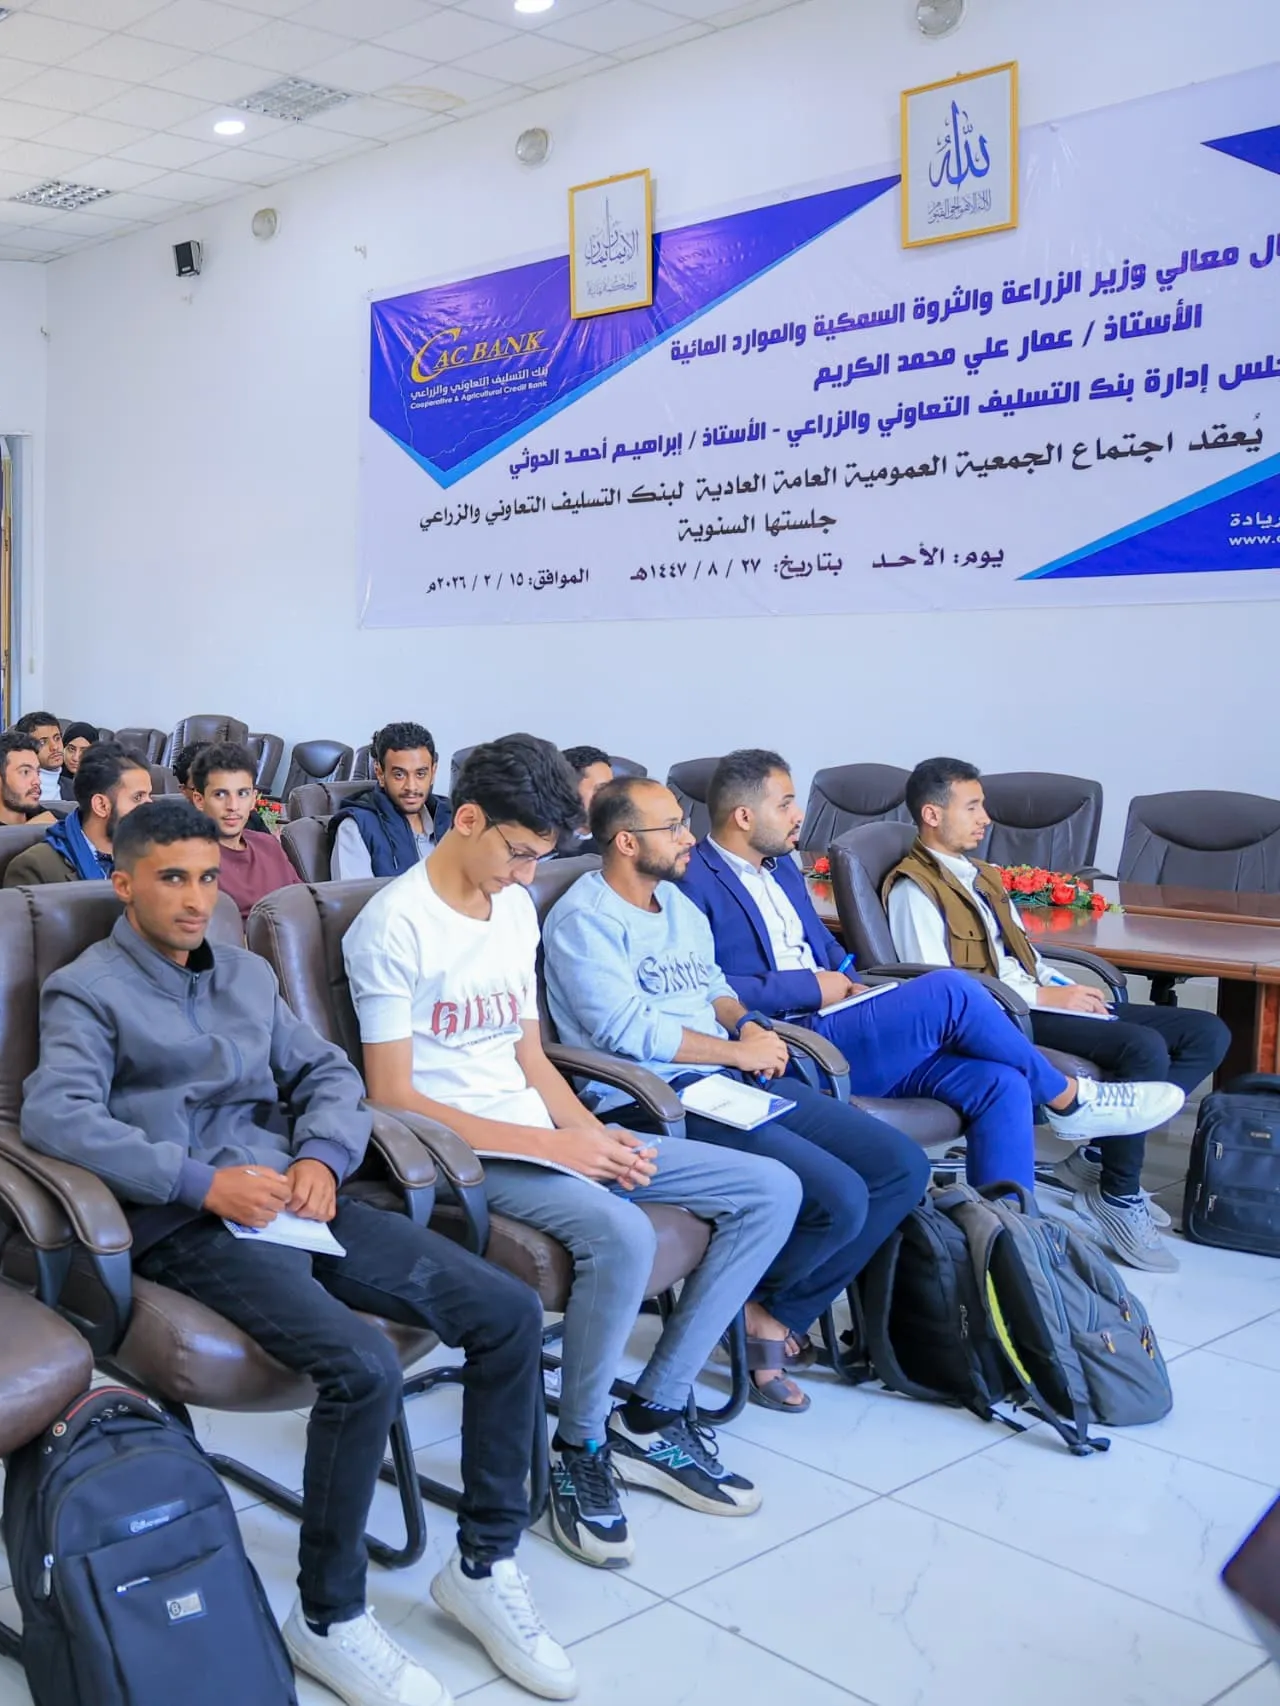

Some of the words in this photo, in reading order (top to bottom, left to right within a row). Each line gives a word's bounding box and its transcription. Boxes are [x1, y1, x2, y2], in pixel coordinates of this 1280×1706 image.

[1089, 259, 1146, 297] وزير
[1156, 246, 1239, 292] معالي
[1002, 270, 1081, 306] الزراعة
[913, 285, 993, 325] والثروة
[1104, 298, 1203, 341] الأستاذ
[732, 321, 807, 355] والموارد
[813, 302, 905, 342] السمكية
[471, 329, 546, 362] BANK
[670, 334, 726, 365] المائية
[897, 347, 956, 372] محمد
[964, 337, 1009, 376] علي
[1016, 328, 1073, 362] عمار
[492, 369, 529, 385] التسليف
[813, 353, 890, 392] الكريم
[1089, 372, 1134, 403] بنك
[1144, 363, 1209, 399] إدارة
[1219, 355, 1280, 390] لس
[978, 380, 1080, 417] التسليف
[702, 417, 767, 447] الأستاذ
[786, 410, 870, 448] والزراعي
[877, 395, 970, 437] التعاوني
[509, 448, 559, 480] الحوثي
[565, 437, 608, 464] أحمد
[612, 432, 683, 463] إبراهيم
[955, 443, 1063, 478] الجمعية
[1072, 431, 1173, 471] اجتماع
[696, 473, 766, 502] العادية
[773, 466, 837, 495] العامة
[844, 454, 947, 488] العمومية
[551, 488, 621, 515] التسليف
[627, 480, 684, 507] لبنك
[419, 504, 481, 532] والزراعي
[485, 496, 546, 526] التعاوني
[765, 508, 837, 537] جلستها
[678, 514, 756, 542] السنوية
[773, 553, 843, 580] بتاريخ:
[872, 541, 945, 569] الأحد
